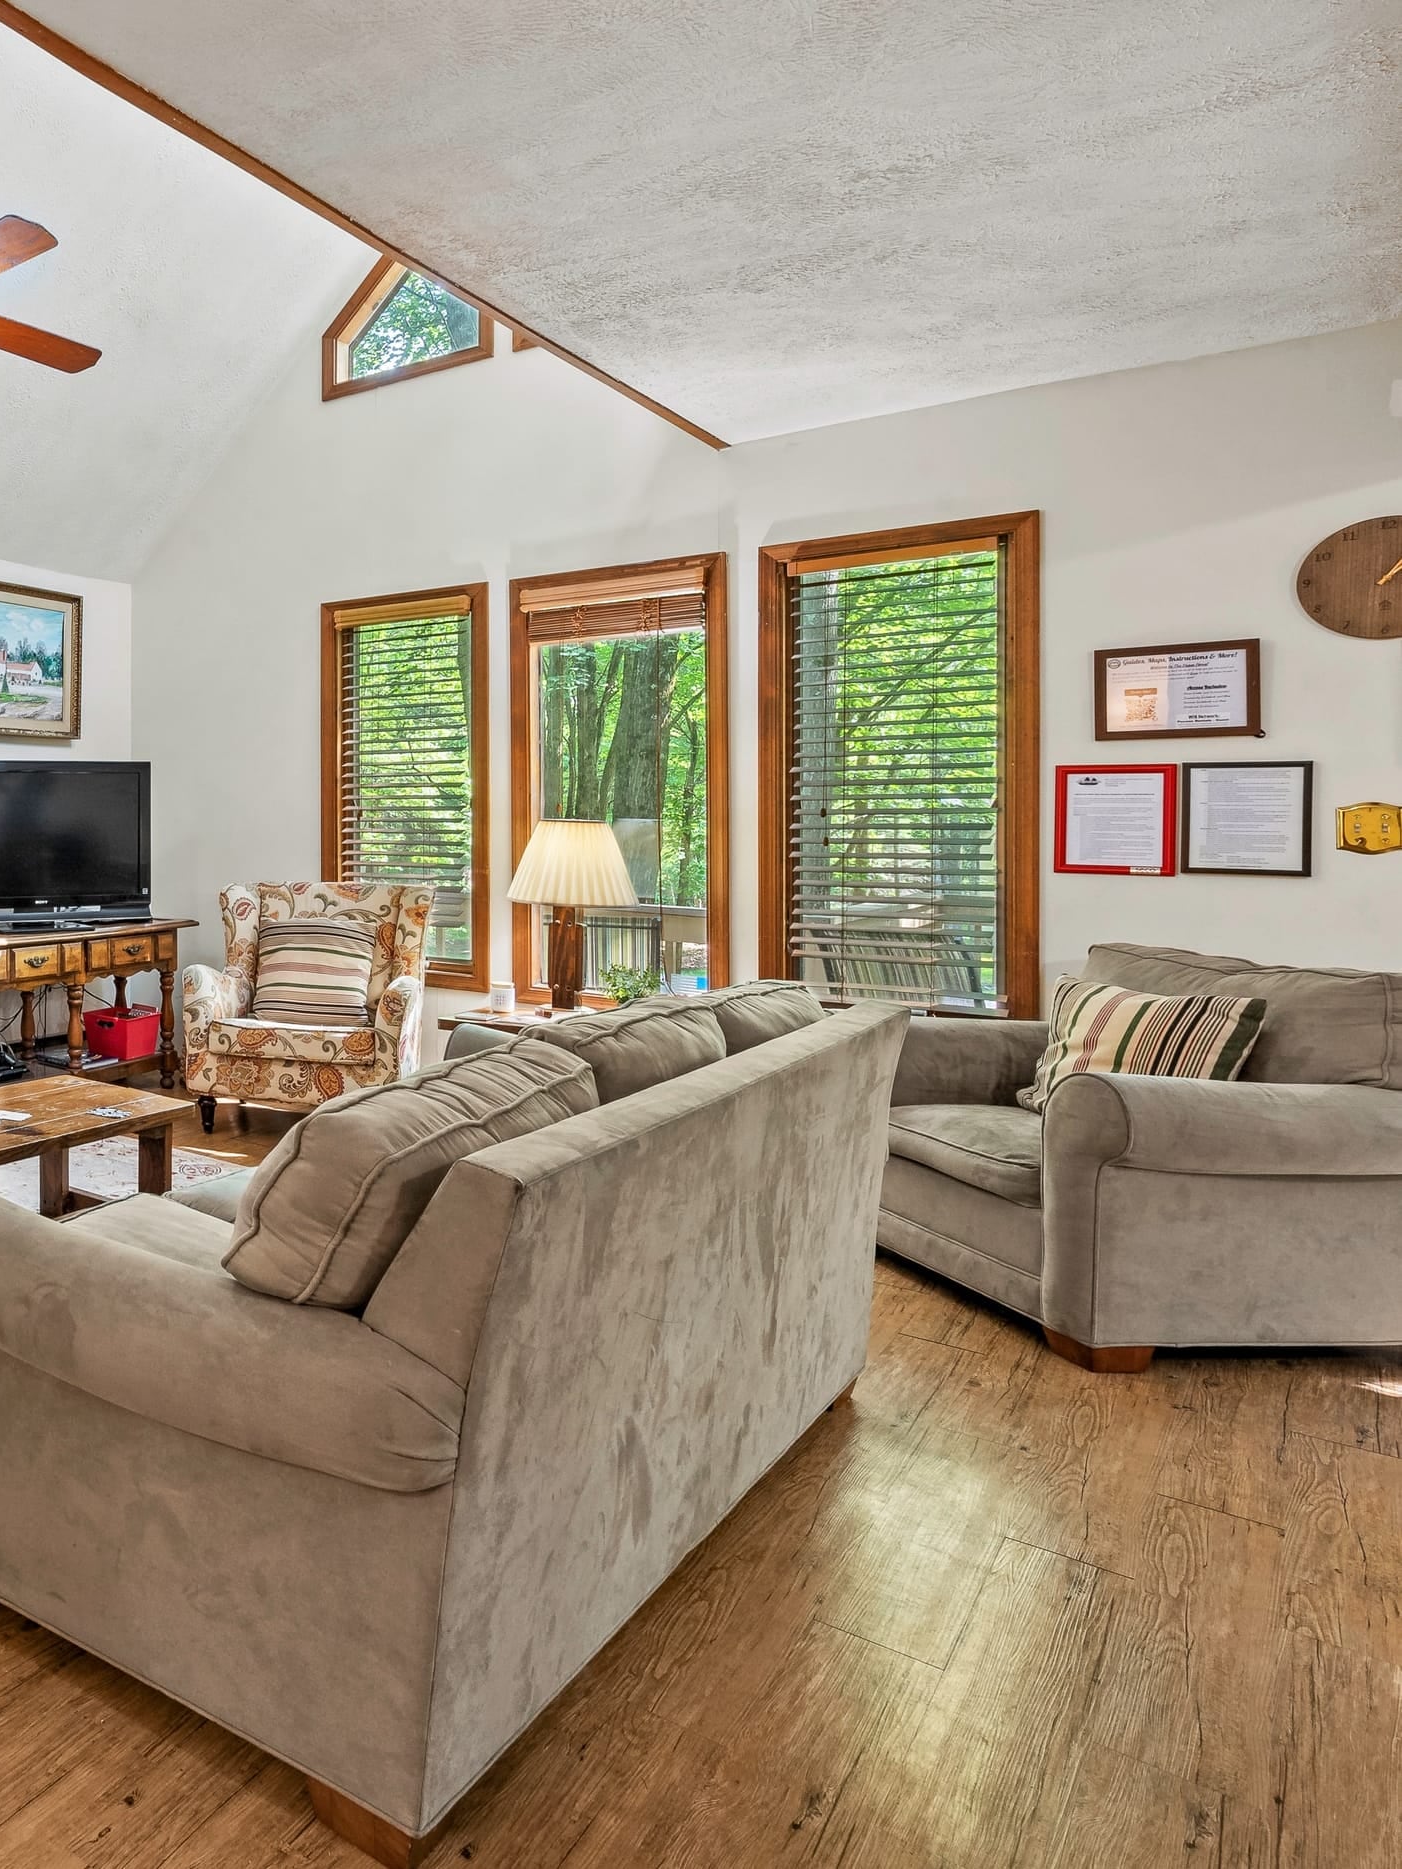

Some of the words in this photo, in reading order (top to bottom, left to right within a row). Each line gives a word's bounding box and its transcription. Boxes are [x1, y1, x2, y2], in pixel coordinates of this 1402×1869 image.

[1381, 520, 1397, 529] 12
[1342, 531, 1358, 541] 11
[1314, 552, 1331, 562] 10
[1302, 578, 1311, 589] 9
[1342, 621, 1350, 630] 7
[1168, 654, 1208, 662] Instructions
